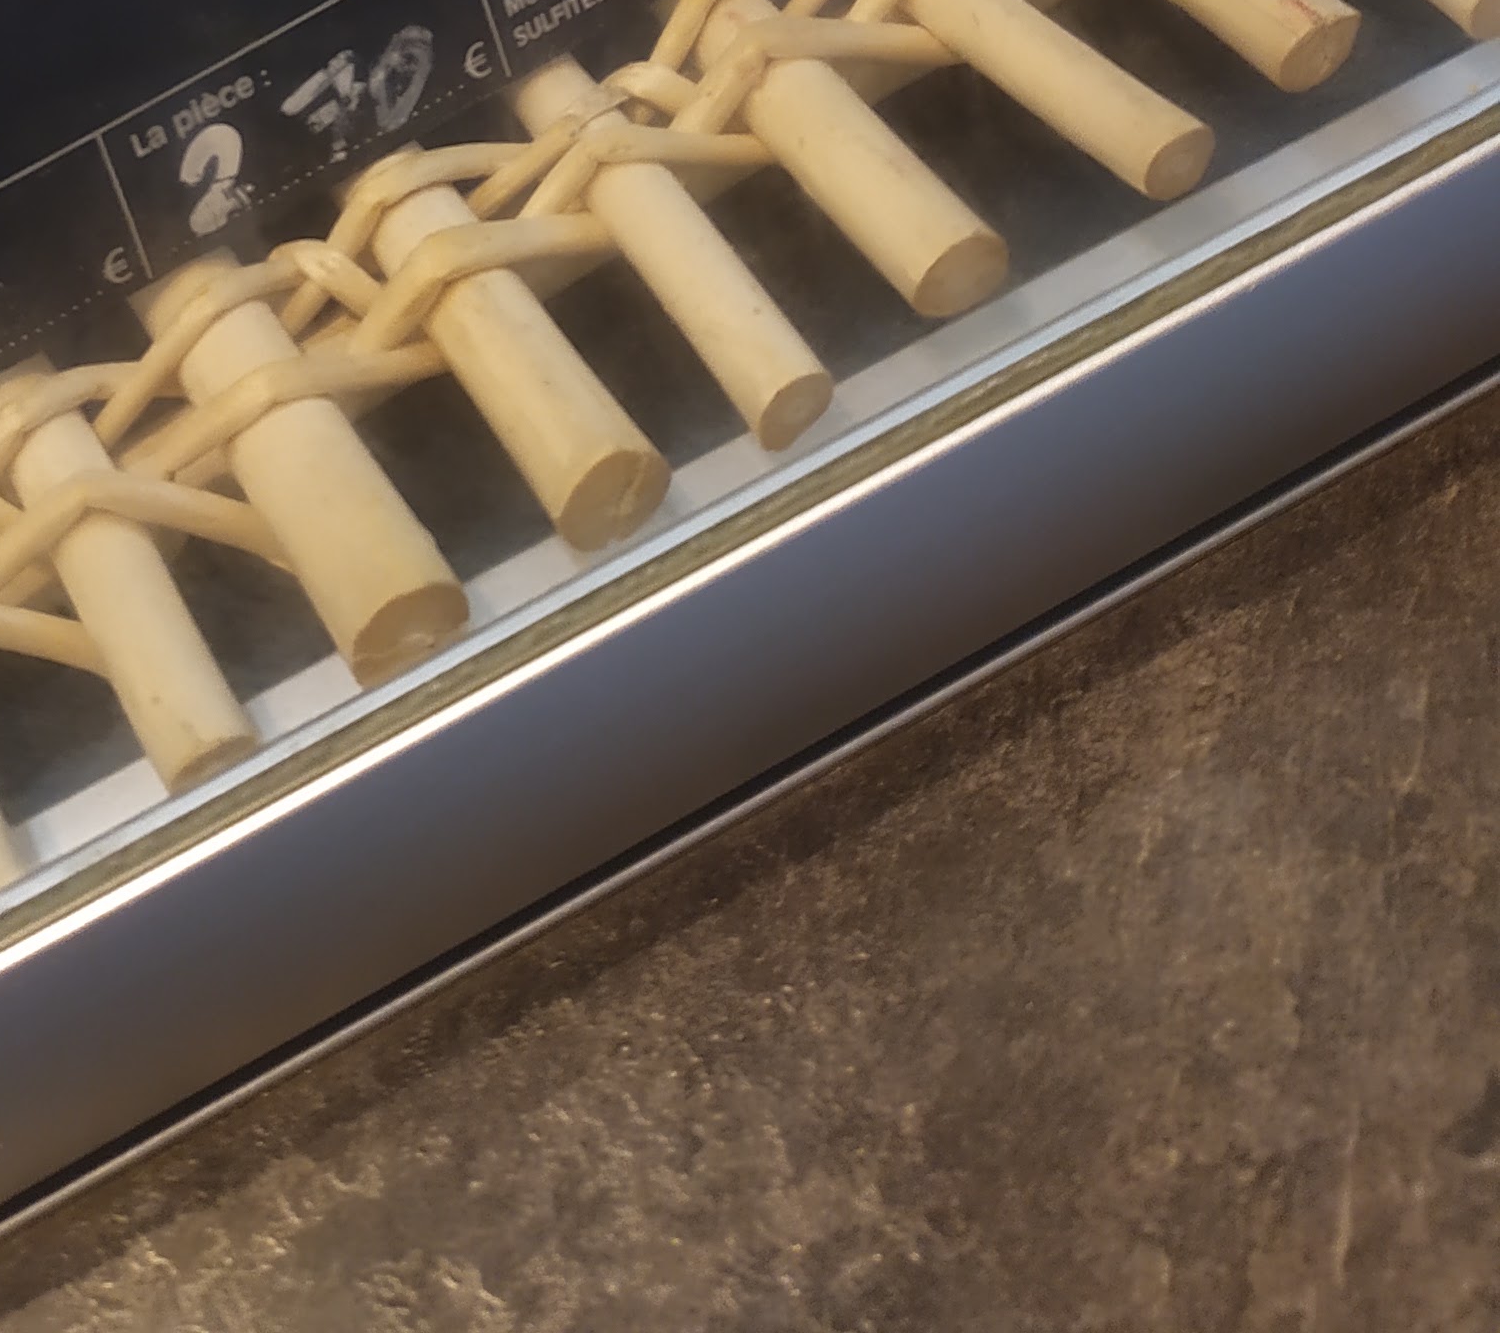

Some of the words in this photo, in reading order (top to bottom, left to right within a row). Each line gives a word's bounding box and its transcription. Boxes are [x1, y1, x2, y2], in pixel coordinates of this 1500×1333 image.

[463, 41, 492, 79] €
[130, 126, 168, 158] La
[102, 247, 133, 284] €
